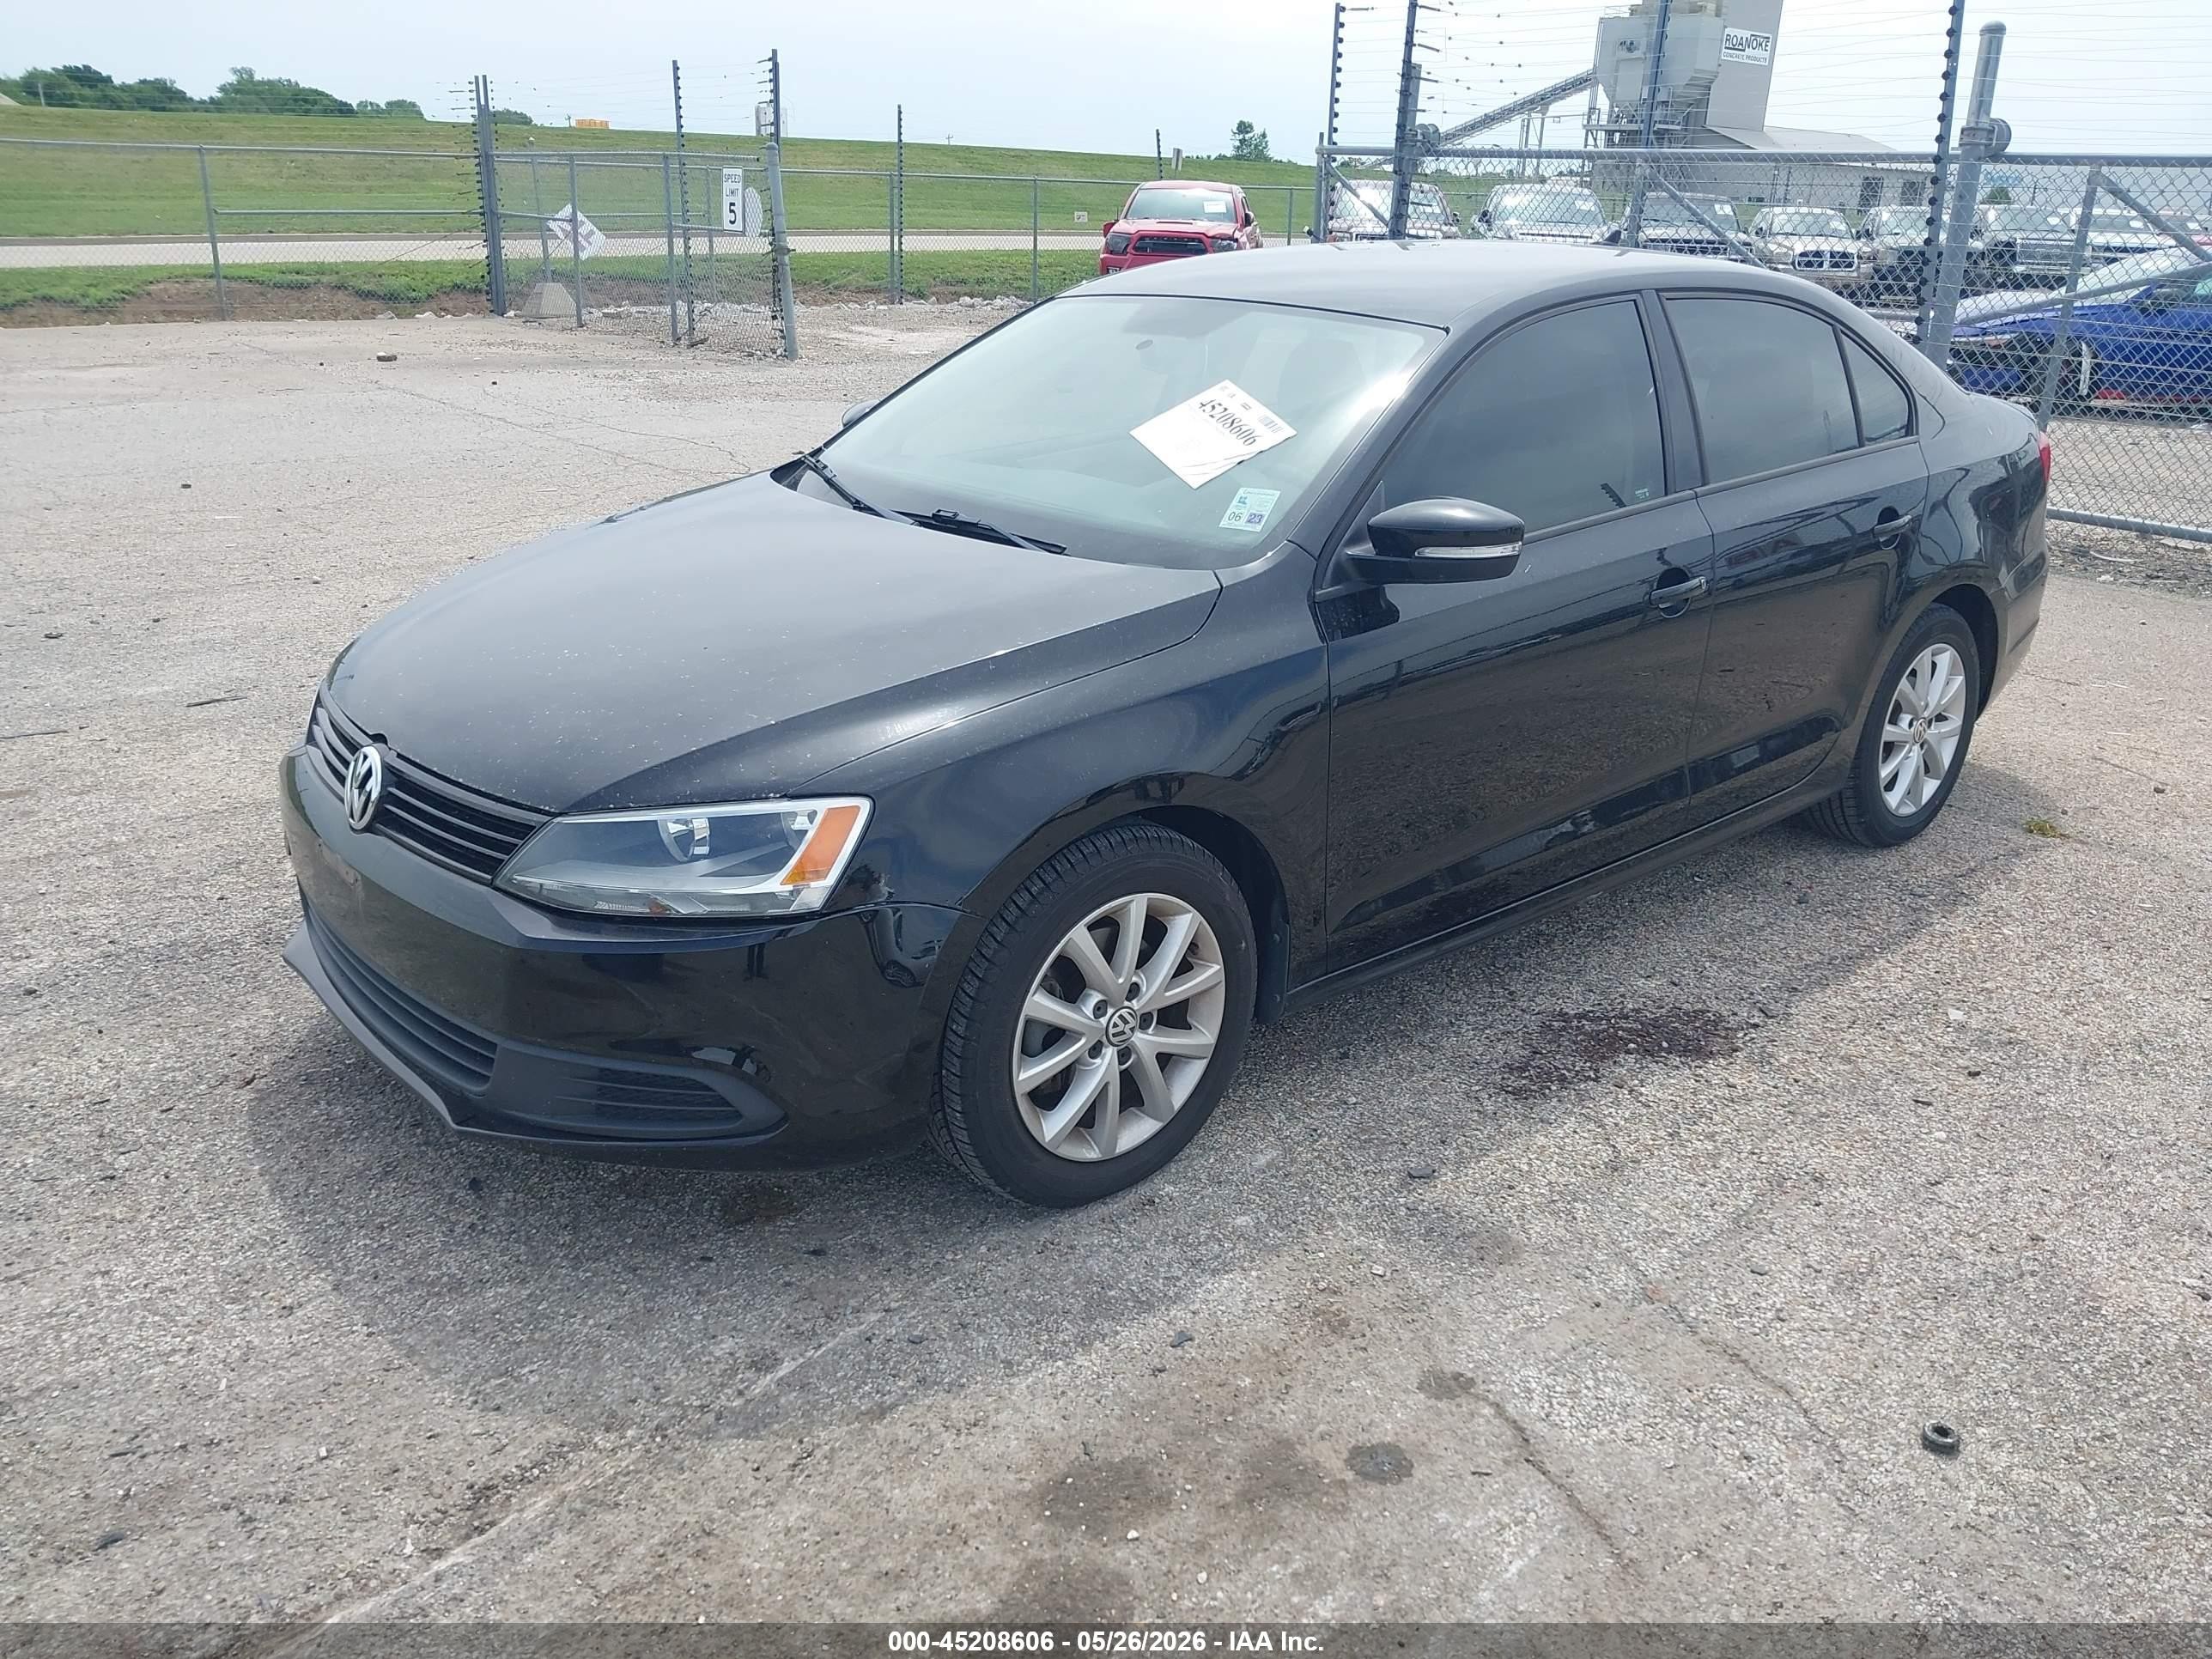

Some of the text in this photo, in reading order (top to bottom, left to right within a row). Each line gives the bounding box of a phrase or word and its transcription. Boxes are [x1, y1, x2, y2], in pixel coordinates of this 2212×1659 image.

[1724, 33, 1770, 52] ROANOKE
[1723, 52, 1767, 64] CONCRETE PRODUCTS
[724, 173, 741, 184] SPEED
[725, 187, 739, 198] LIMIT
[728, 202, 737, 225] 5
[1199, 399, 1263, 446] 45208606
[1228, 511, 1263, 524] 06 23
